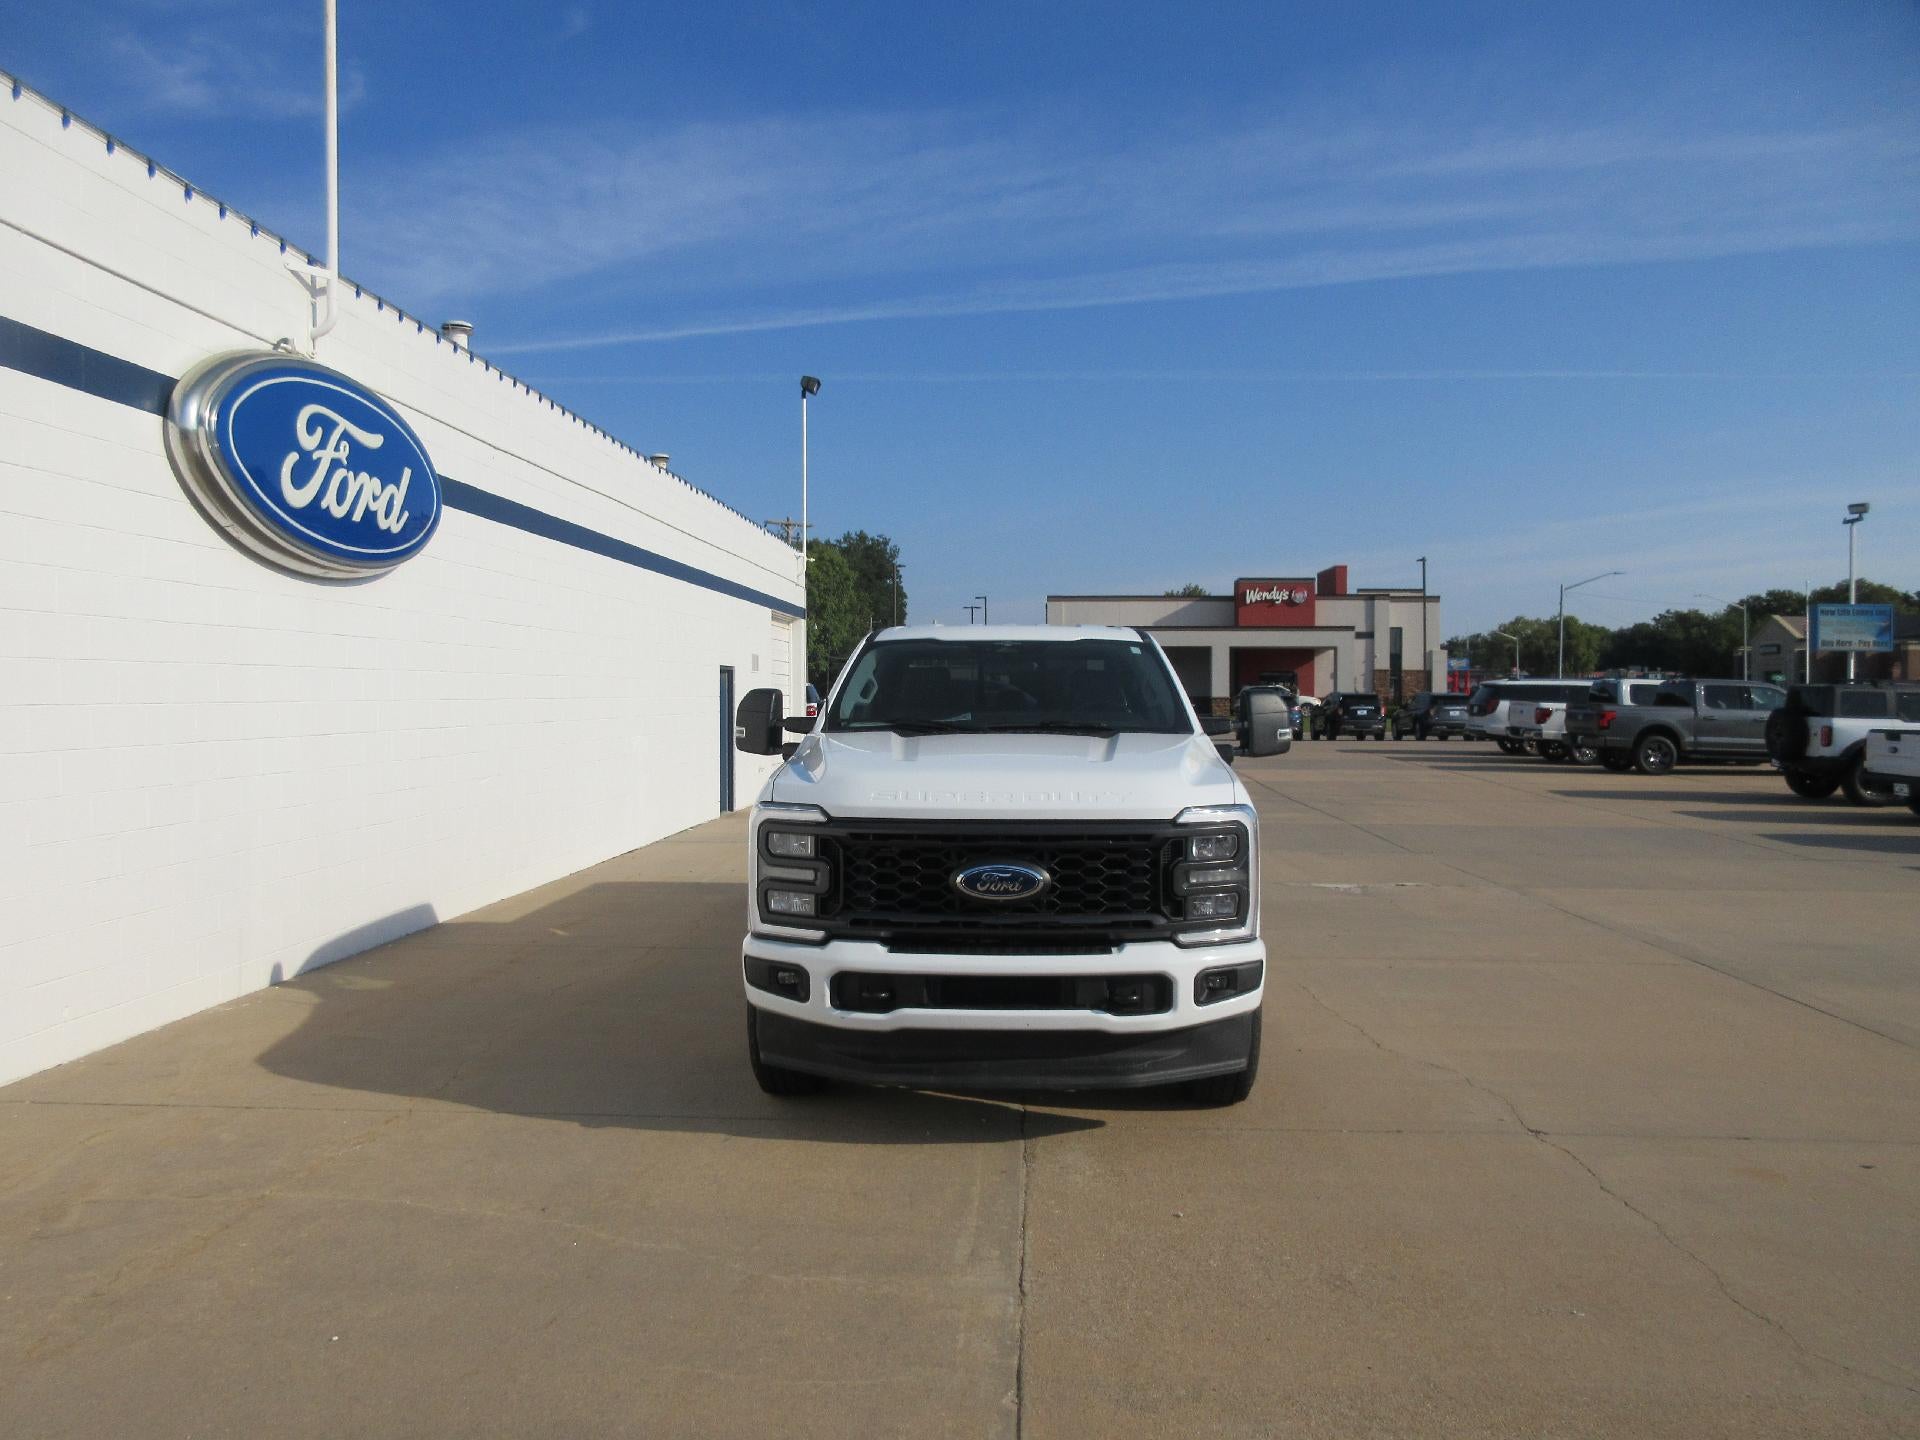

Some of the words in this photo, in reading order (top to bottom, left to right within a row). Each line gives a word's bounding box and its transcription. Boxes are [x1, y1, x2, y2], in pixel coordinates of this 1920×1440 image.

[281, 404, 412, 534] Ford
[1245, 585, 1290, 605] Wendy's
[977, 872, 1024, 892] Ford
